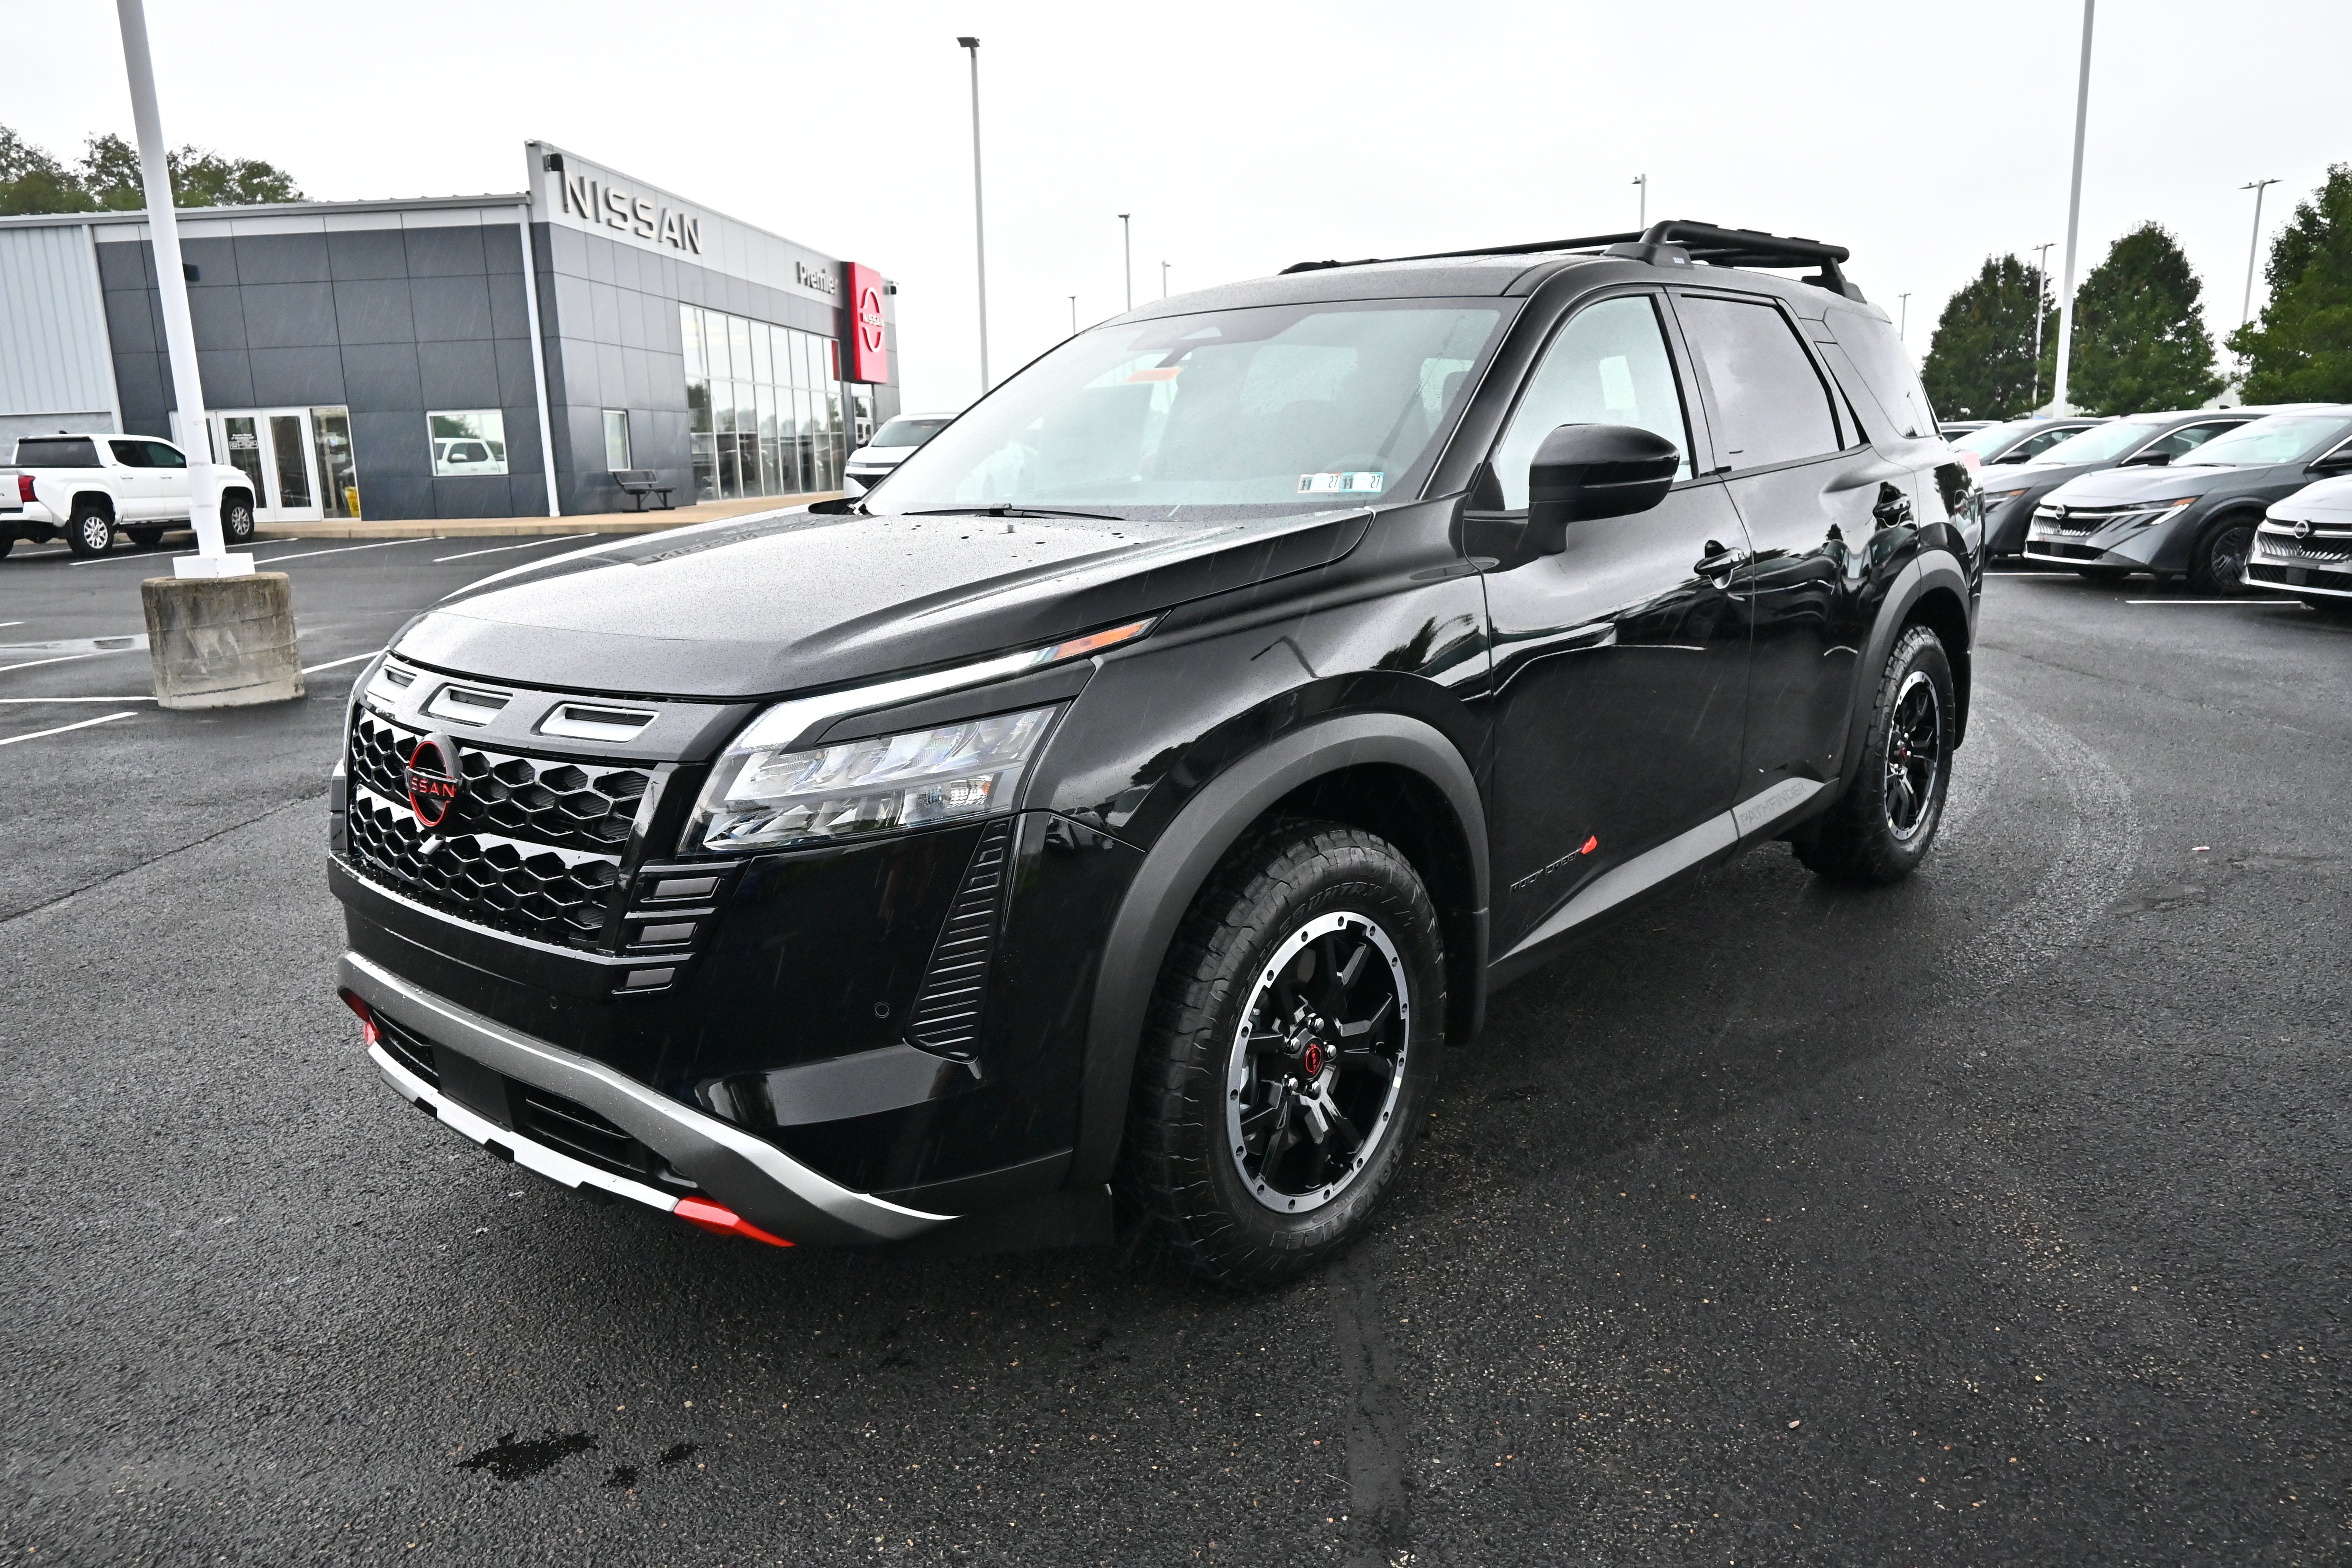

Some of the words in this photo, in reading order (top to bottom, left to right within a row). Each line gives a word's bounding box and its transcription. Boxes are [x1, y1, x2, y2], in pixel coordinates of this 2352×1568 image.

[561, 169, 702, 254] NISSAN
[797, 261, 838, 294] Premier
[860, 312, 885, 327] NISSAN
[1329, 476, 1338, 487] 27
[1371, 476, 1380, 487] 27
[411, 776, 455, 798] SSAN
